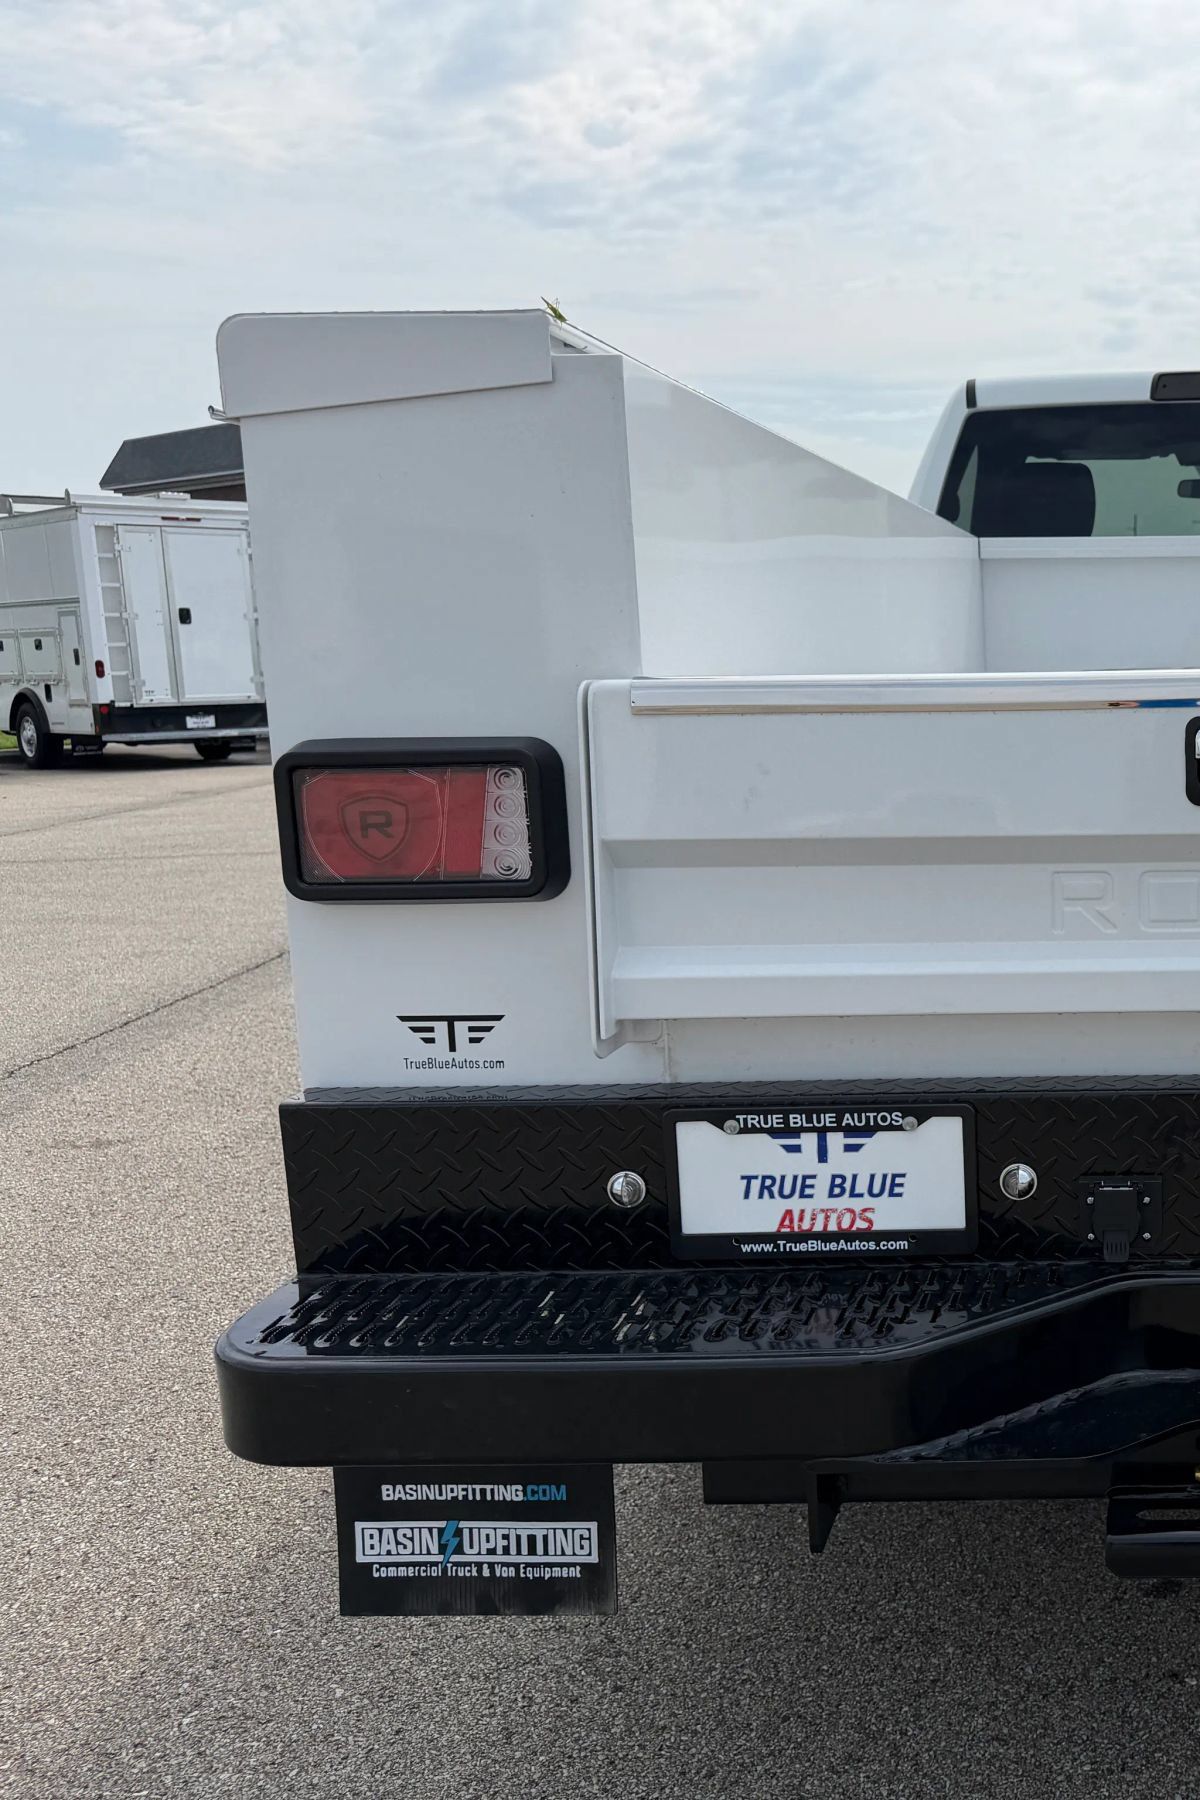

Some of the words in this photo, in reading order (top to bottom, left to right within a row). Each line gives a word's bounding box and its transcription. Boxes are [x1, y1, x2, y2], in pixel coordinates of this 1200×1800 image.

[359, 810, 394, 840] R
[403, 1057, 505, 1070] TrueBlueAutos.com
[736, 1113, 784, 1129] TRUE
[788, 1113, 836, 1128] BLUE
[841, 1112, 903, 1128] AUTOS
[740, 1175, 817, 1200] TRUE
[828, 1173, 907, 1198] BLUE
[775, 1207, 875, 1232] AUTOS
[740, 1239, 909, 1253] www.TrueBlueAutos.com
[381, 1484, 567, 1501] BASINUPFITTING.COM
[363, 1528, 439, 1556] BASIN
[462, 1528, 590, 1556] UPFITTING
[372, 1564, 442, 1578] Commercial
[447, 1564, 478, 1577] Truck
[482, 1564, 491, 1577] &
[495, 1565, 515, 1577] Van
[520, 1565, 581, 1580] Equipment
